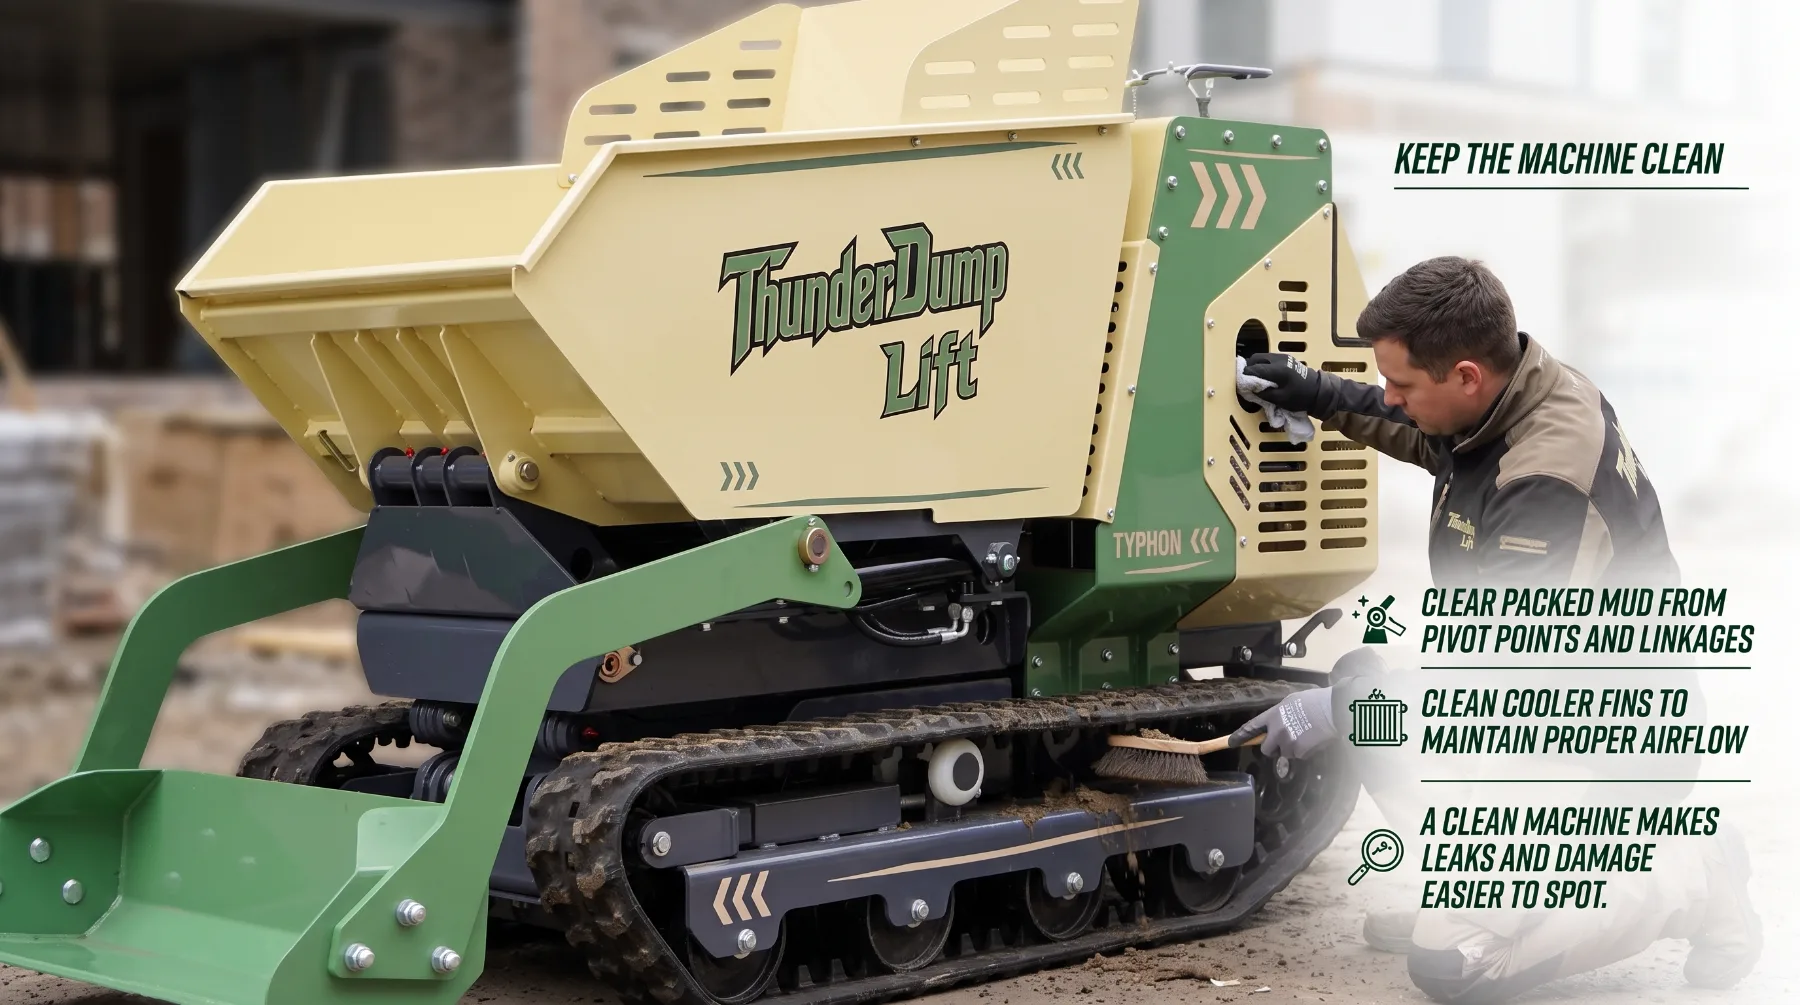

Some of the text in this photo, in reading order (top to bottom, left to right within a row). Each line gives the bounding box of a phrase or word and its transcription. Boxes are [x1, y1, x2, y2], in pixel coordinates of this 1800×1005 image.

[718, 222, 1009, 377] ThunderDump
[880, 329, 978, 421] Lift
[1113, 529, 1182, 559] TYPHON
